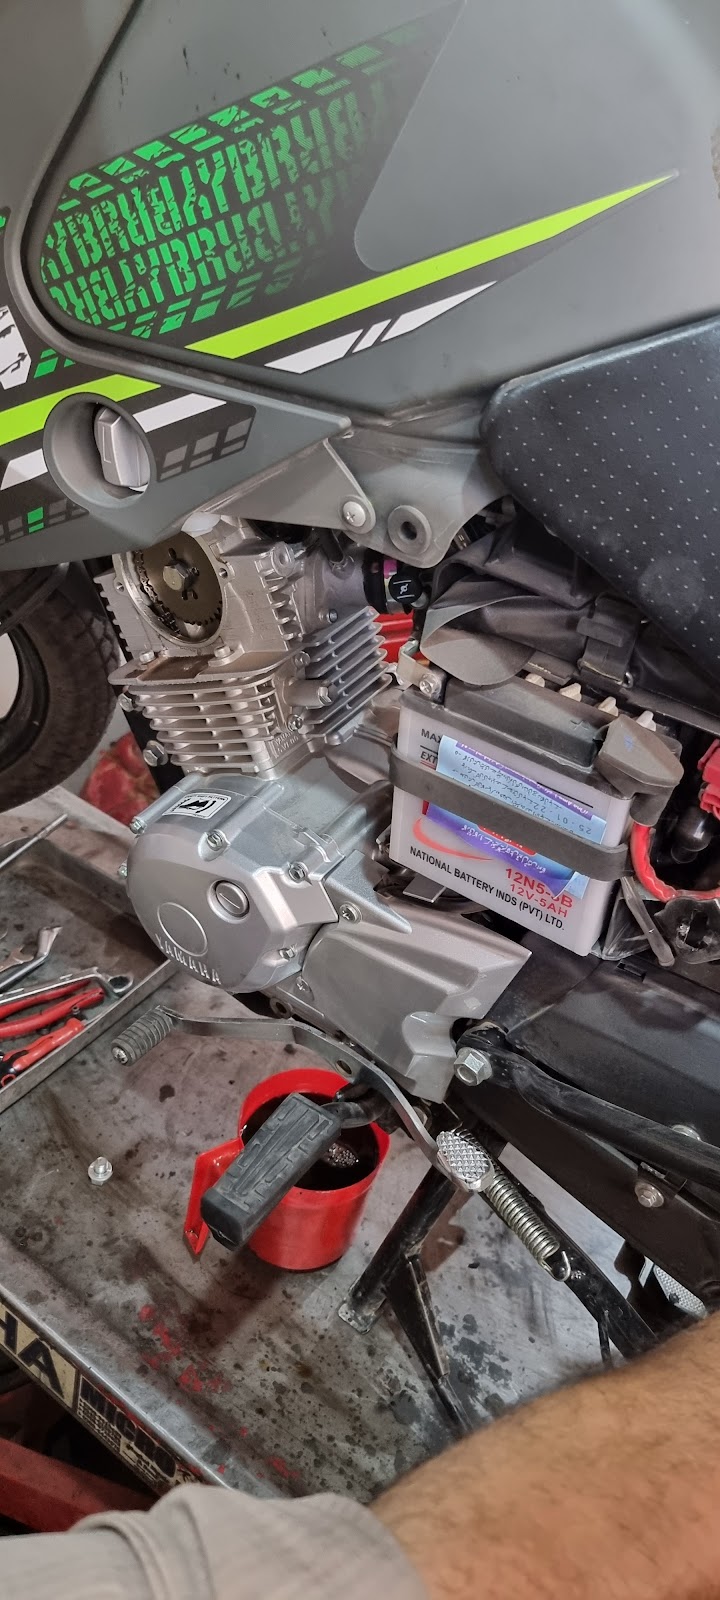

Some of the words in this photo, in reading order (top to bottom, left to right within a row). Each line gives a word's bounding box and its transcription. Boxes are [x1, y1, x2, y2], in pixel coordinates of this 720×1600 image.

[410, 846, 452, 874] NATIONAL
[454, 869, 494, 895] BATTERY
[495, 888, 518, 906] INDS
[519, 900, 544, 922] (PVT)
[545, 914, 565, 931] LTD.
[505, 867, 573, 908] 12N5-B
[509, 883, 568, 918] 12V-5AH
[154, 932, 222, 985] YAMAHA
